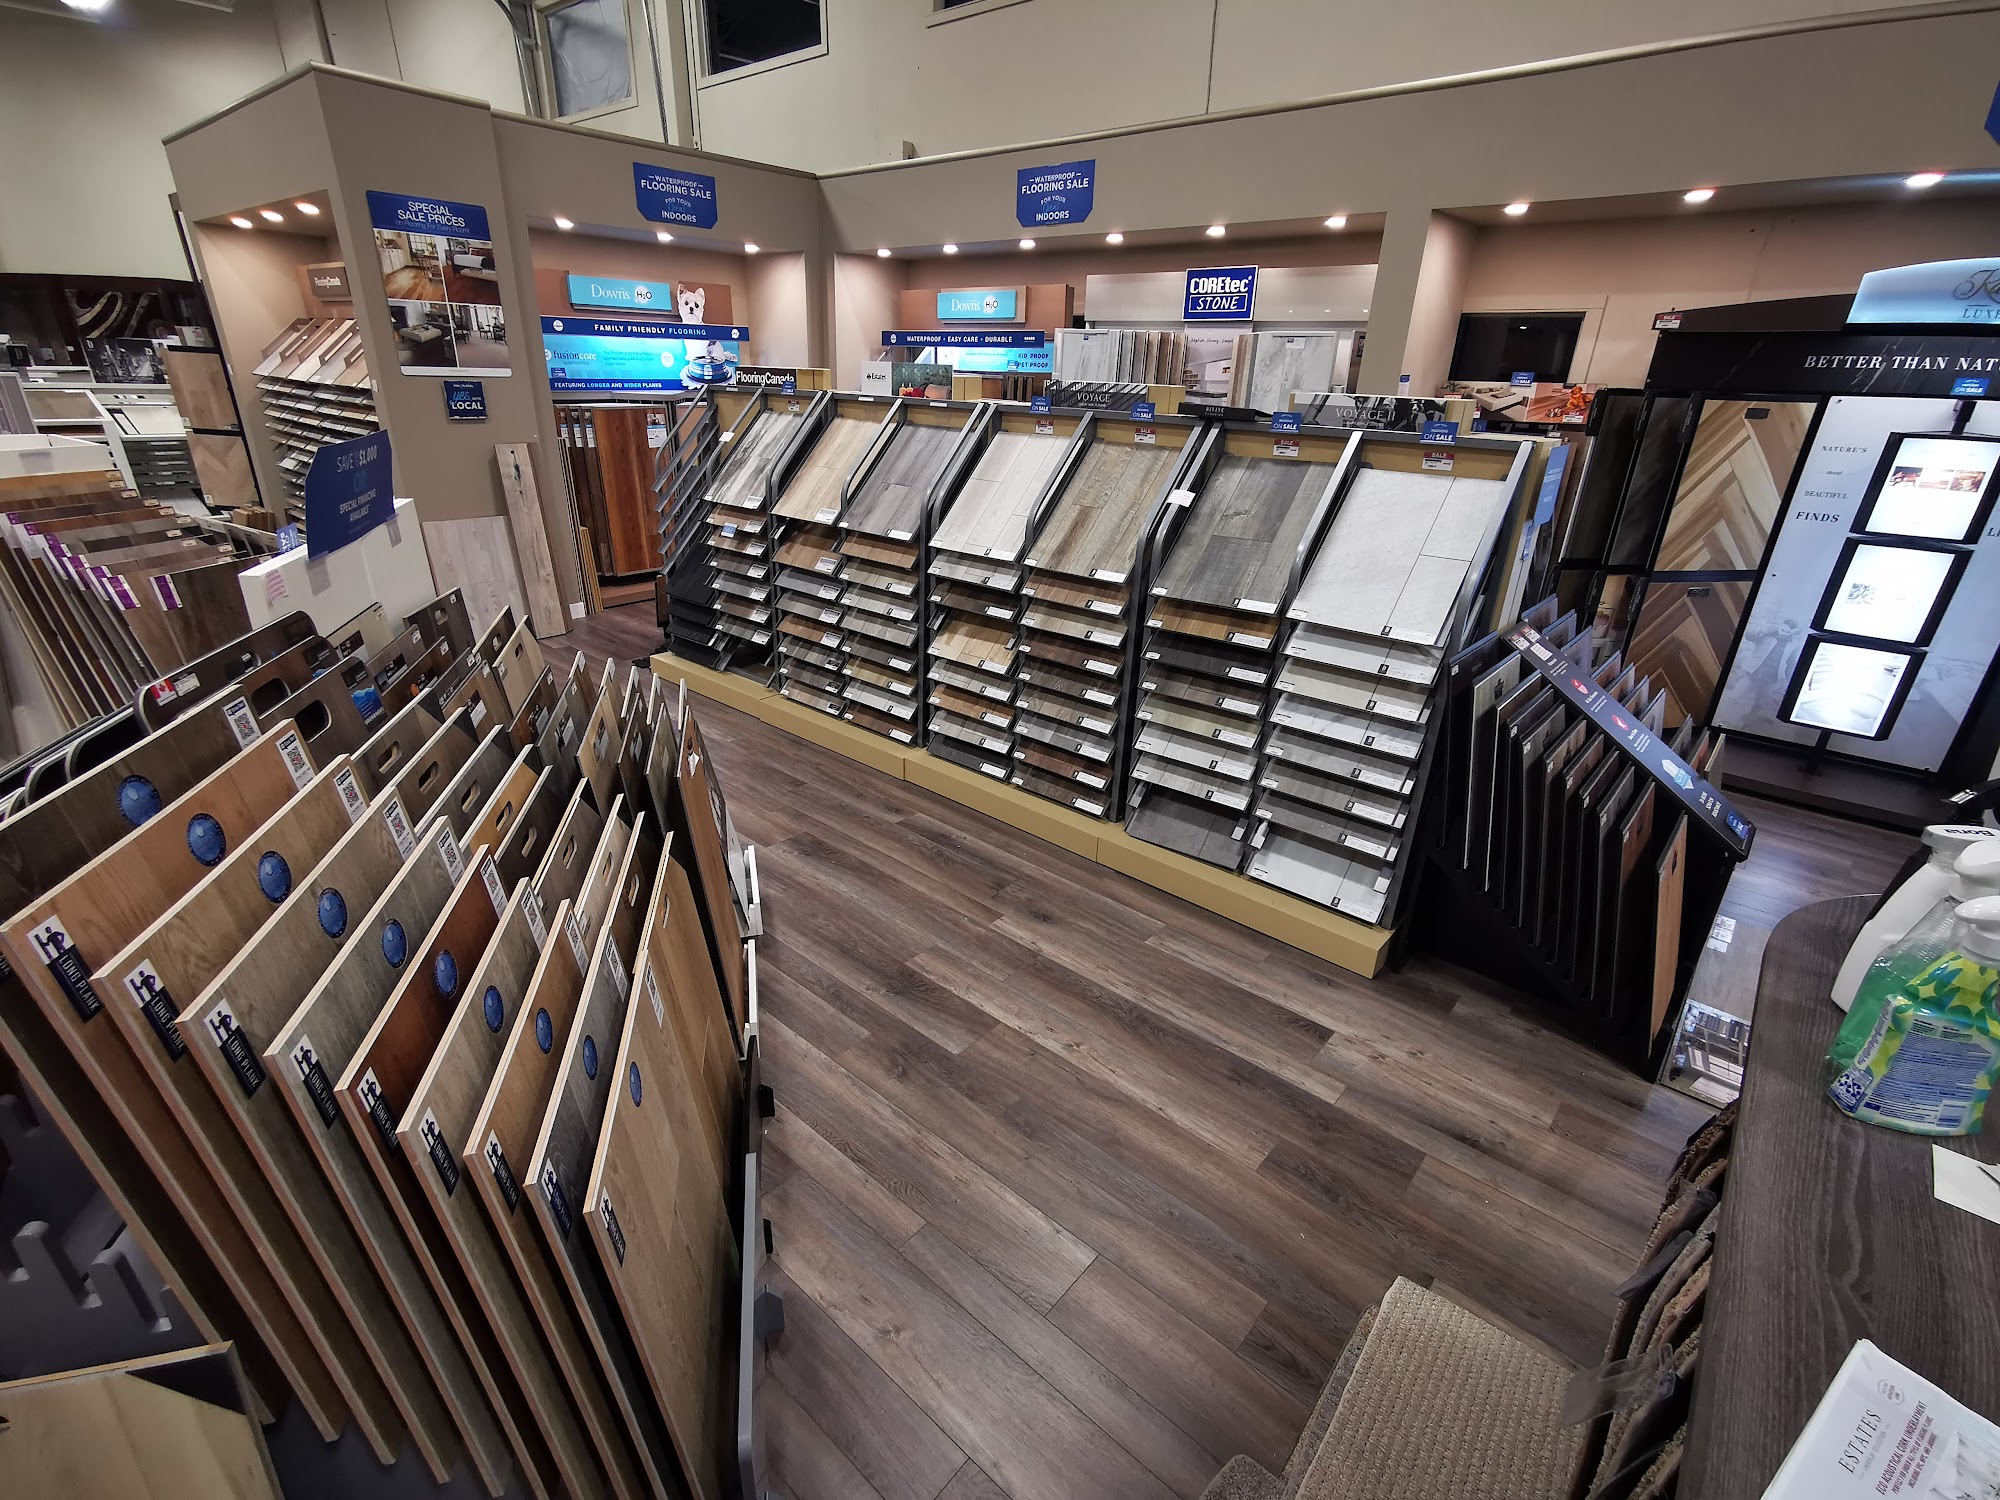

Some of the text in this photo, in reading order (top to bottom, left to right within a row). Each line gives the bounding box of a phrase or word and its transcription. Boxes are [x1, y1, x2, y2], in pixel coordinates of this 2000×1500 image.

[655, 175, 697, 188] WATERPROOF
[1035, 172, 1075, 183] WATERPROOF
[641, 180, 712, 200] FLOORING SALE
[1022, 178, 1089, 194] FLOORING SALE
[677, 198, 691, 208] YOUR
[1041, 195, 1066, 205] FOR YOUR
[407, 201, 453, 216] SPECIAL
[662, 210, 697, 222] INDOORS
[1036, 210, 1070, 222] INDOORS
[397, 210, 466, 228] SALE PRICES
[591, 284, 630, 300] Downs
[1190, 276, 1249, 294] COREtec
[952, 299, 981, 312] Downs
[1196, 296, 1240, 310] STONE
[594, 324, 707, 336] FAMILY FRIENDLY FLOORING
[554, 350, 598, 360] fusioncore
[1804, 355, 1882, 370] BETTER
[1891, 356, 1950, 370] THAN
[736, 370, 794, 388] FlooringCanada
[450, 391, 470, 406] yes
[452, 402, 484, 410] LOCAL
[1336, 408, 1396, 420] VOYAGE II
[336, 445, 378, 472] SAVE $1,000
[340, 489, 377, 514] SPECIAL FINANCING
[1804, 490, 1848, 499] BEAUTIFUL
[350, 505, 370, 522] AVAILABLE
[1795, 511, 1840, 523] FINDS
[1944, 828, 1996, 836] Bona
[59, 954, 100, 1012] LONG PLANK
[151, 997, 186, 1050] LONG PLANK
[228, 1036, 260, 1088] LONG PLANK
[309, 1069, 337, 1119] LONG PLANK
[374, 1101, 398, 1147] LONG PLANK
[434, 1140, 456, 1185] LONG PLANK
[1903, 1400, 1927, 1439] UNDERLAYMENT
[1838, 1409, 1881, 1474] ESTATES
[1896, 1436, 1910, 1452] CORK
[1881, 1450, 1903, 1484] ACOUSTICAL
[1875, 1481, 1888, 1495] ECO
